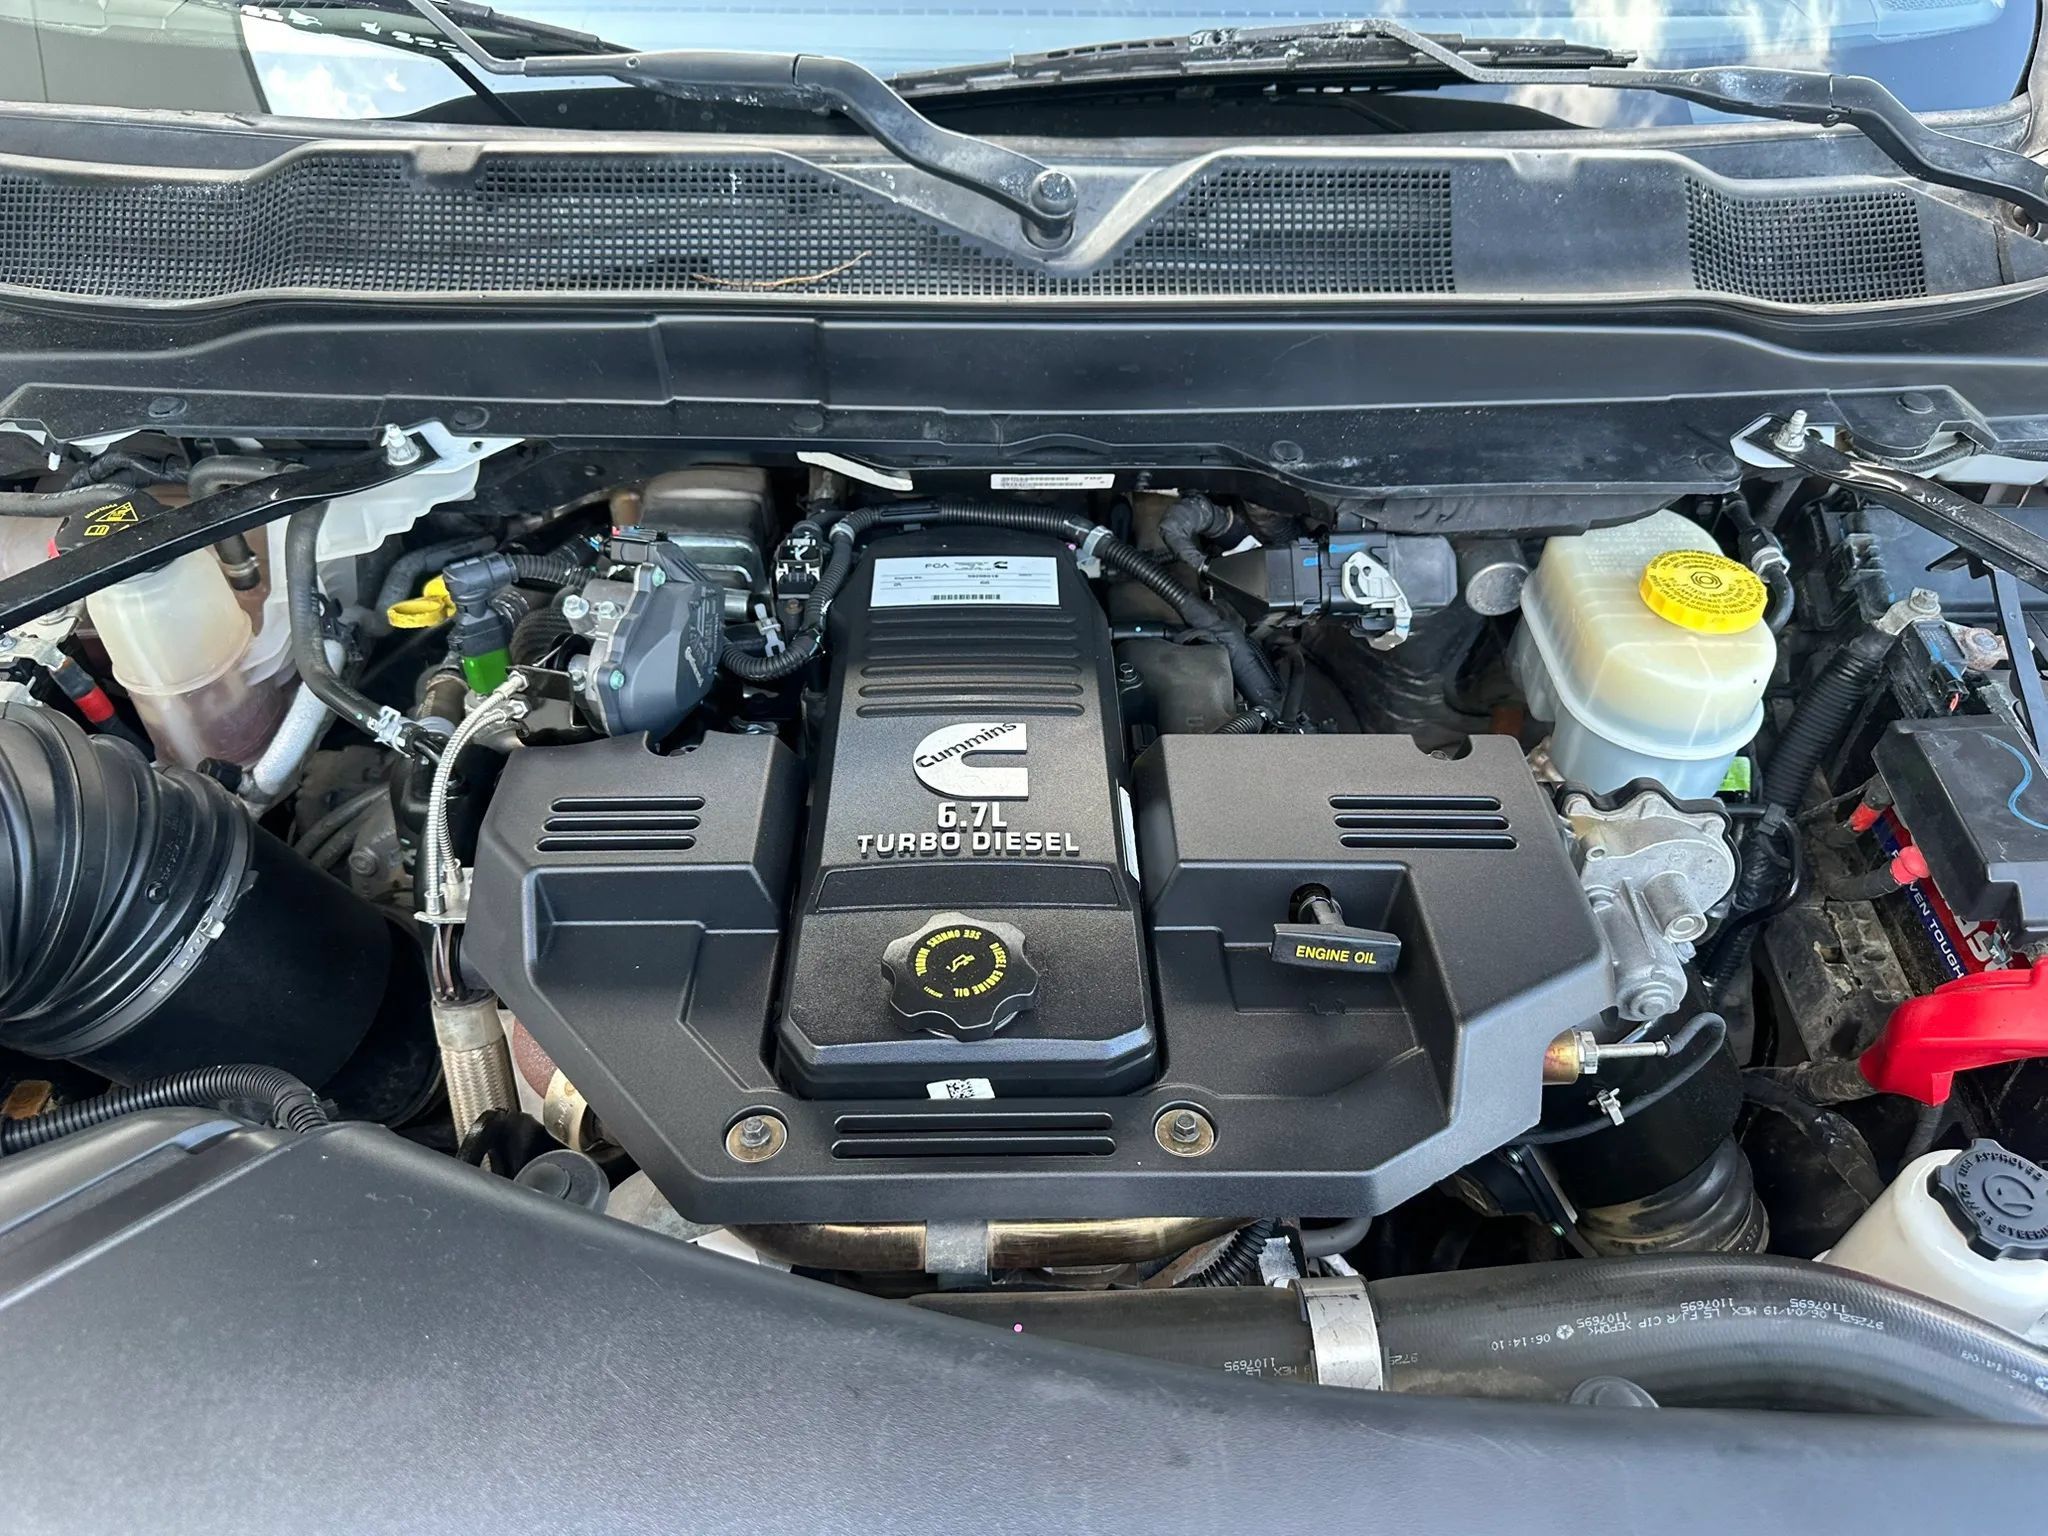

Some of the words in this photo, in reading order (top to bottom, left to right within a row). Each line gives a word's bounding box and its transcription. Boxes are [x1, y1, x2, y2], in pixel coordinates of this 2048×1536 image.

[915, 722, 1017, 768] Cummins
[938, 802, 1008, 833] 6.7L
[857, 832, 961, 858] TURBO
[972, 831, 1081, 857] DIESEL
[963, 929, 982, 940] SEE
[988, 941, 1007, 969] DIESEL
[1295, 945, 1350, 962] ENGINE
[1353, 951, 1377, 965] OIL
[1929, 917, 1965, 980] TOUGH
[971, 969, 1004, 995] ENGINE
[953, 987, 971, 998] OIL
[1680, 1298, 1733, 1313] 1107695
[1731, 1306, 1757, 1316] MEX
[1789, 1298, 1847, 1314] 1107695
[1576, 1311, 1628, 1328] 1107695
[1638, 1316, 1662, 1327] CIP
[1491, 1333, 1551, 1351] 06:14:10
[1224, 1357, 1275, 1372] 1107695
